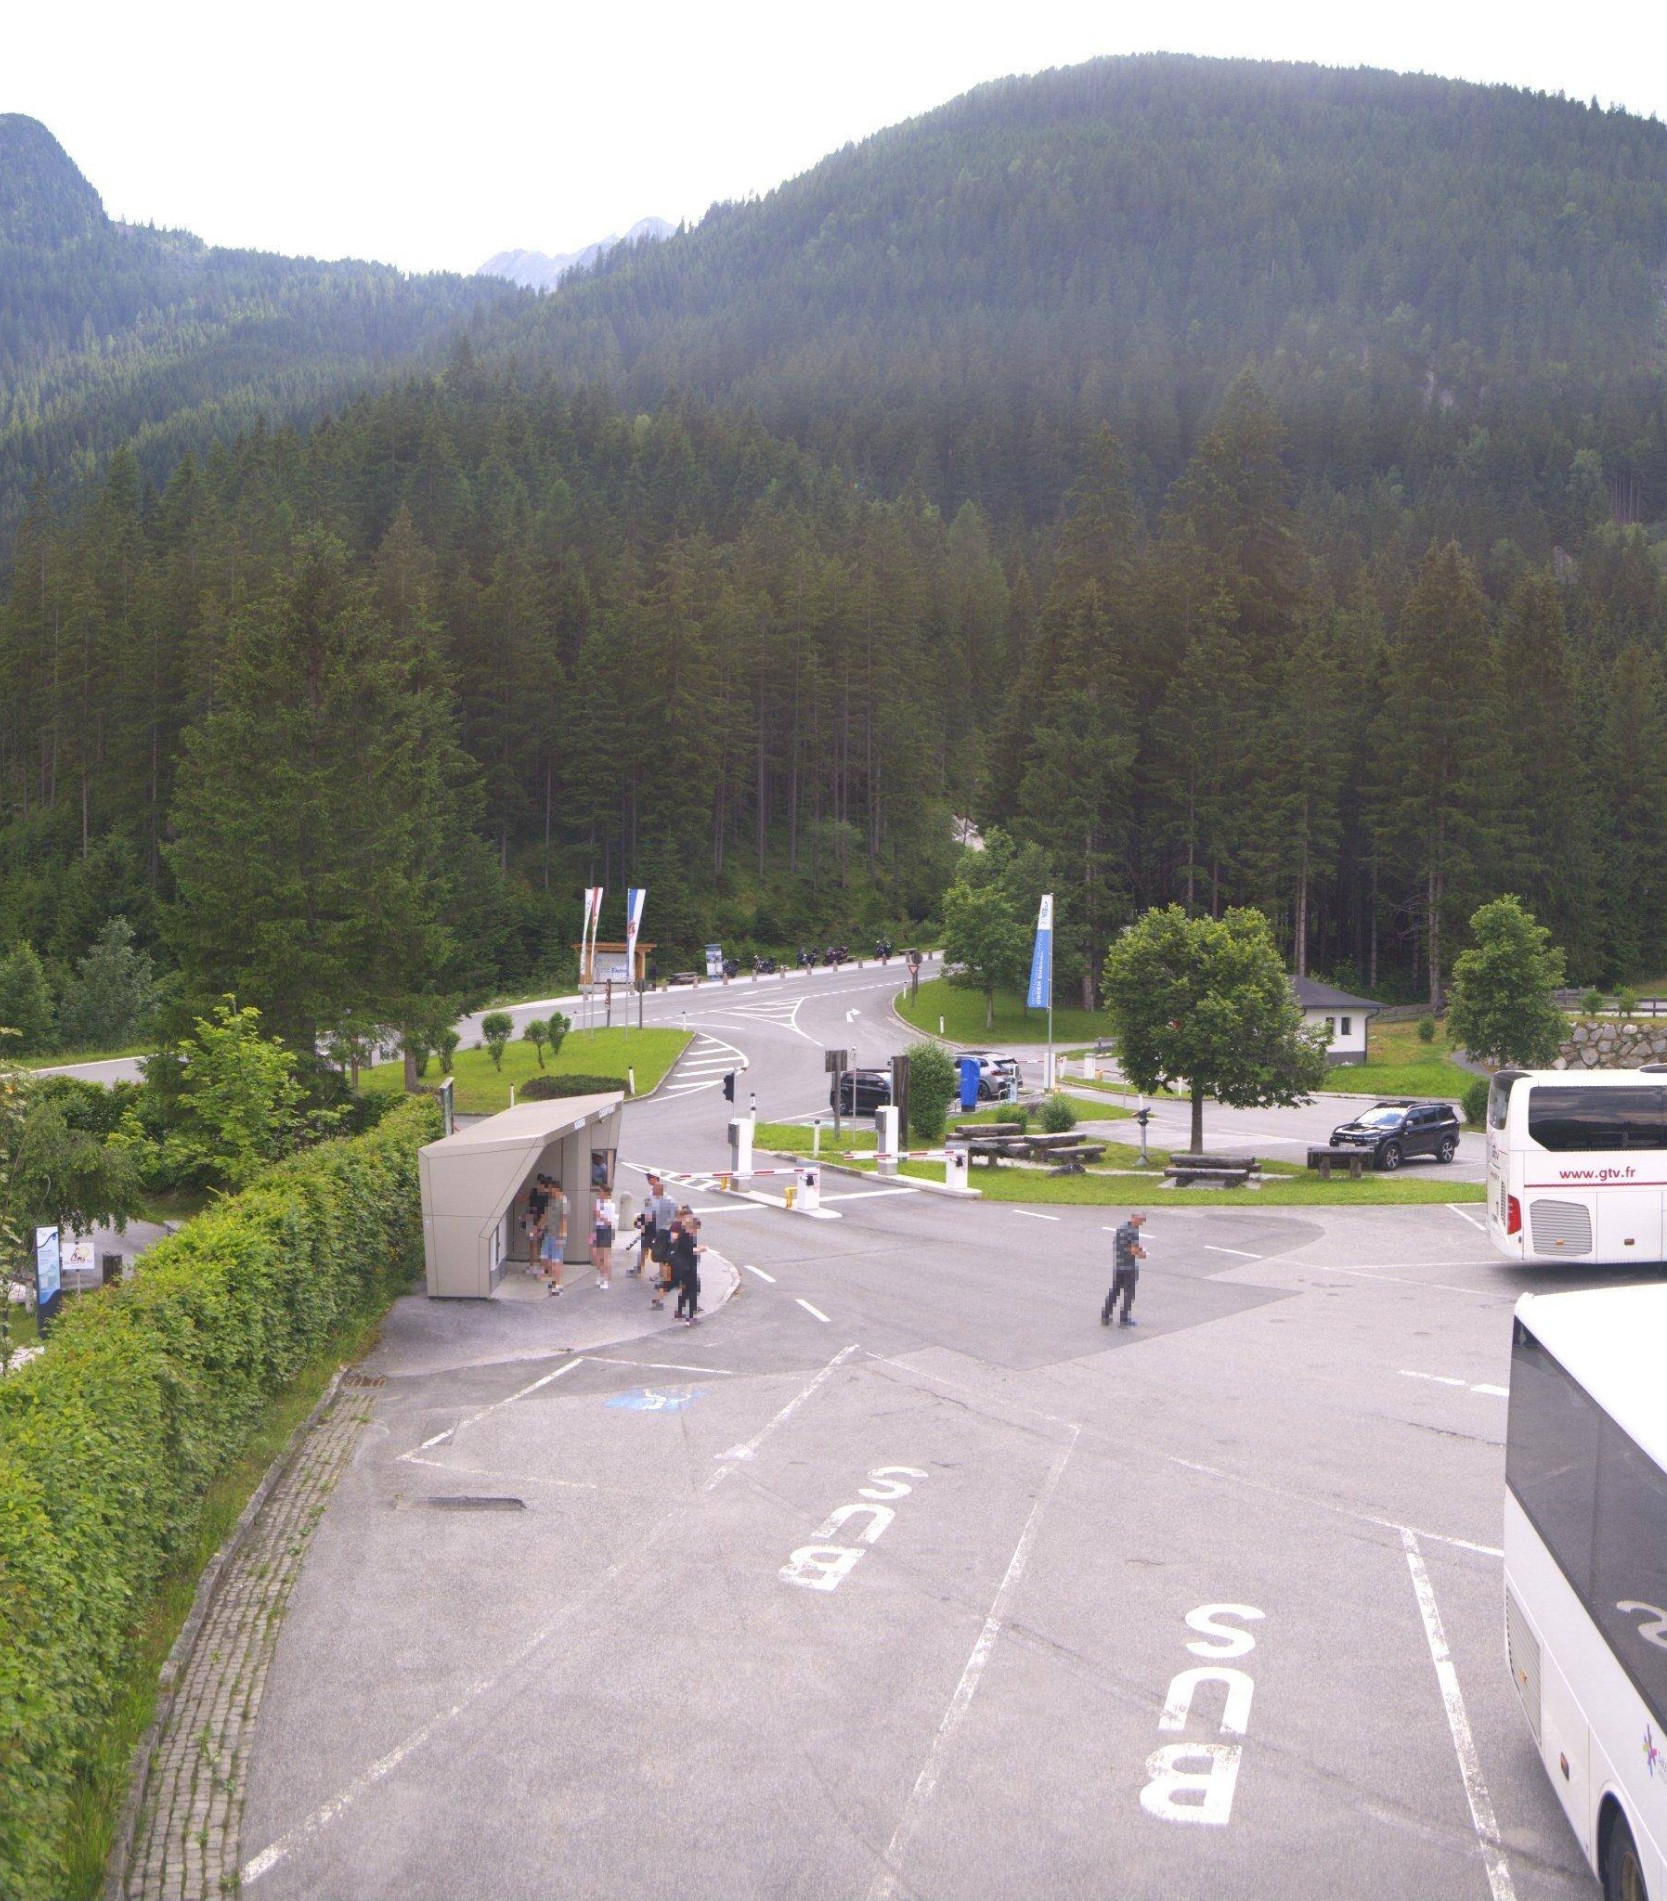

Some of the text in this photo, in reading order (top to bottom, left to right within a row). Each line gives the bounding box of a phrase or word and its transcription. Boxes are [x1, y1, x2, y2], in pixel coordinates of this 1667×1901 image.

[1560, 1166, 1636, 1181] www.gtv.fr
[779, 1466, 929, 1591] BUS
[1140, 1603, 1267, 1825] BUS
